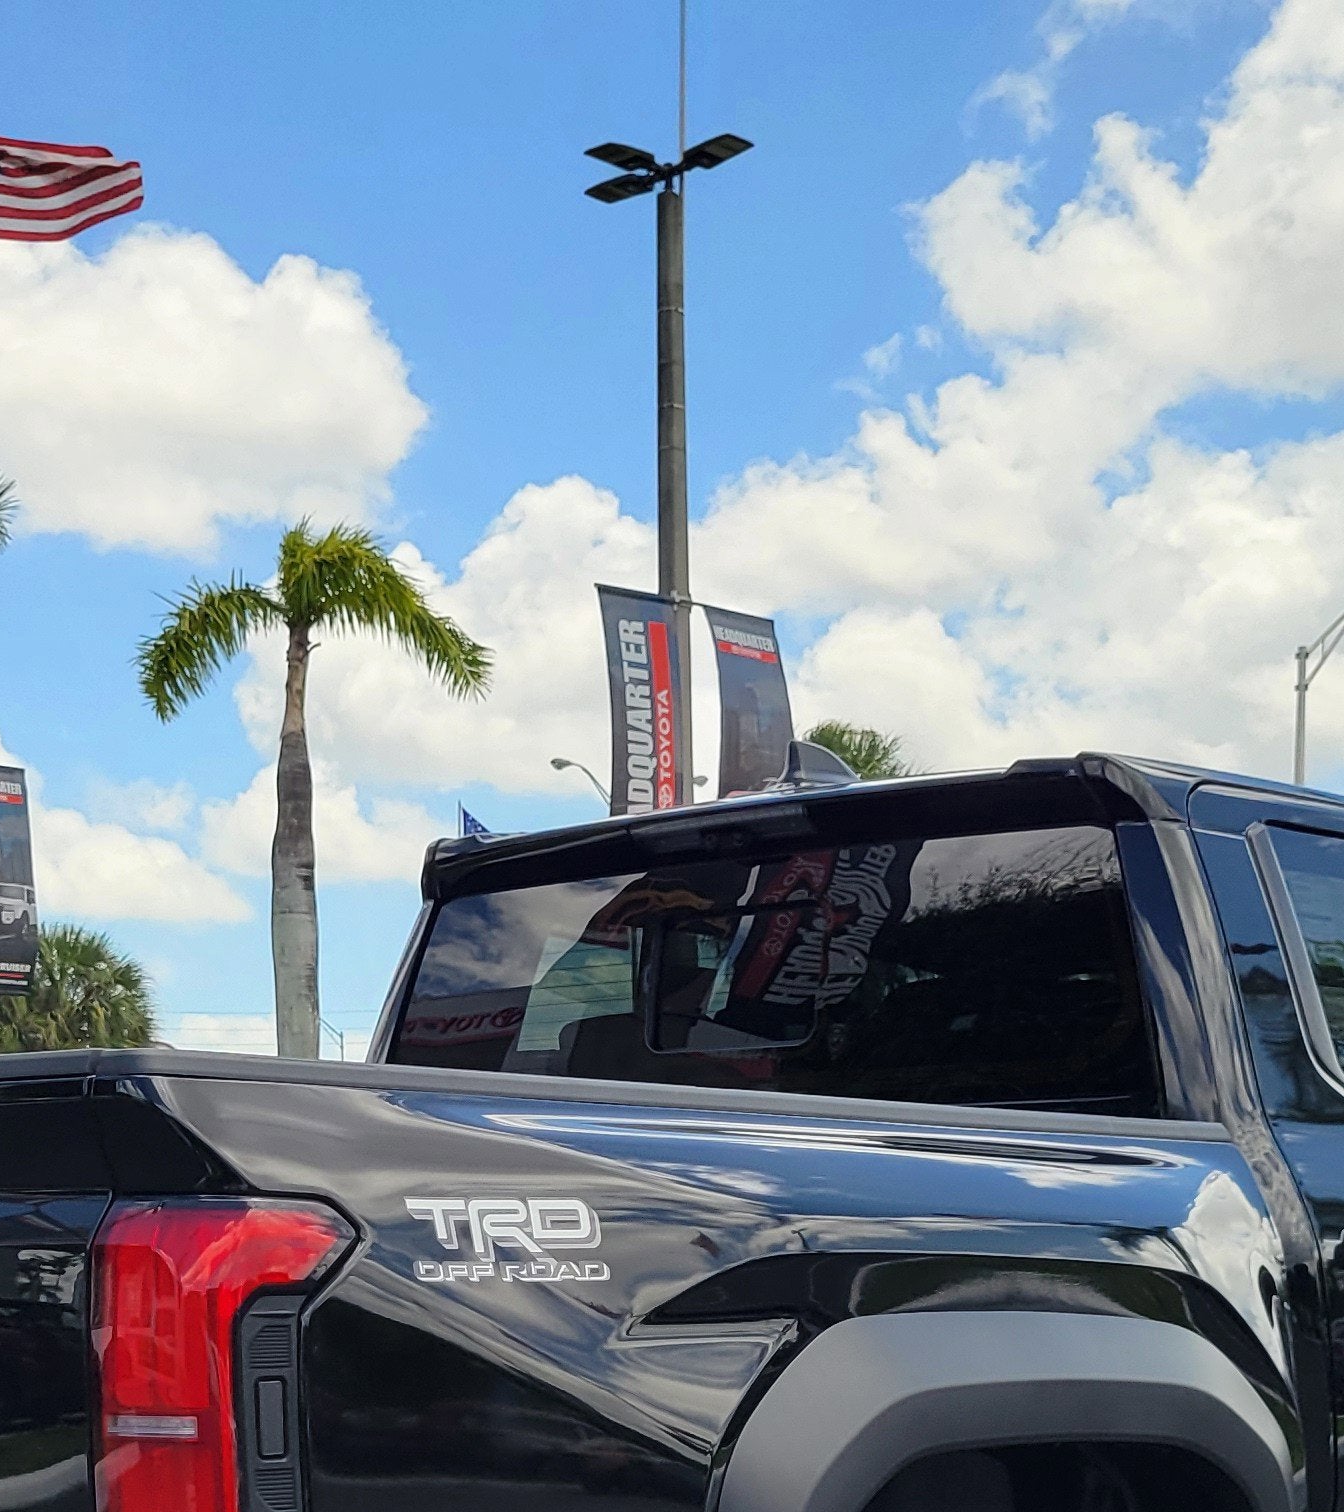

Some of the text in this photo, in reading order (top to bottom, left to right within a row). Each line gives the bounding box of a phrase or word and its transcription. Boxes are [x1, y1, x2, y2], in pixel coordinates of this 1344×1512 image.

[618, 618, 657, 814] DQUARTER
[657, 689, 673, 779] TOYOTA
[404, 1197, 602, 1262] TRD
[413, 1260, 611, 1283] OFF ROAD
